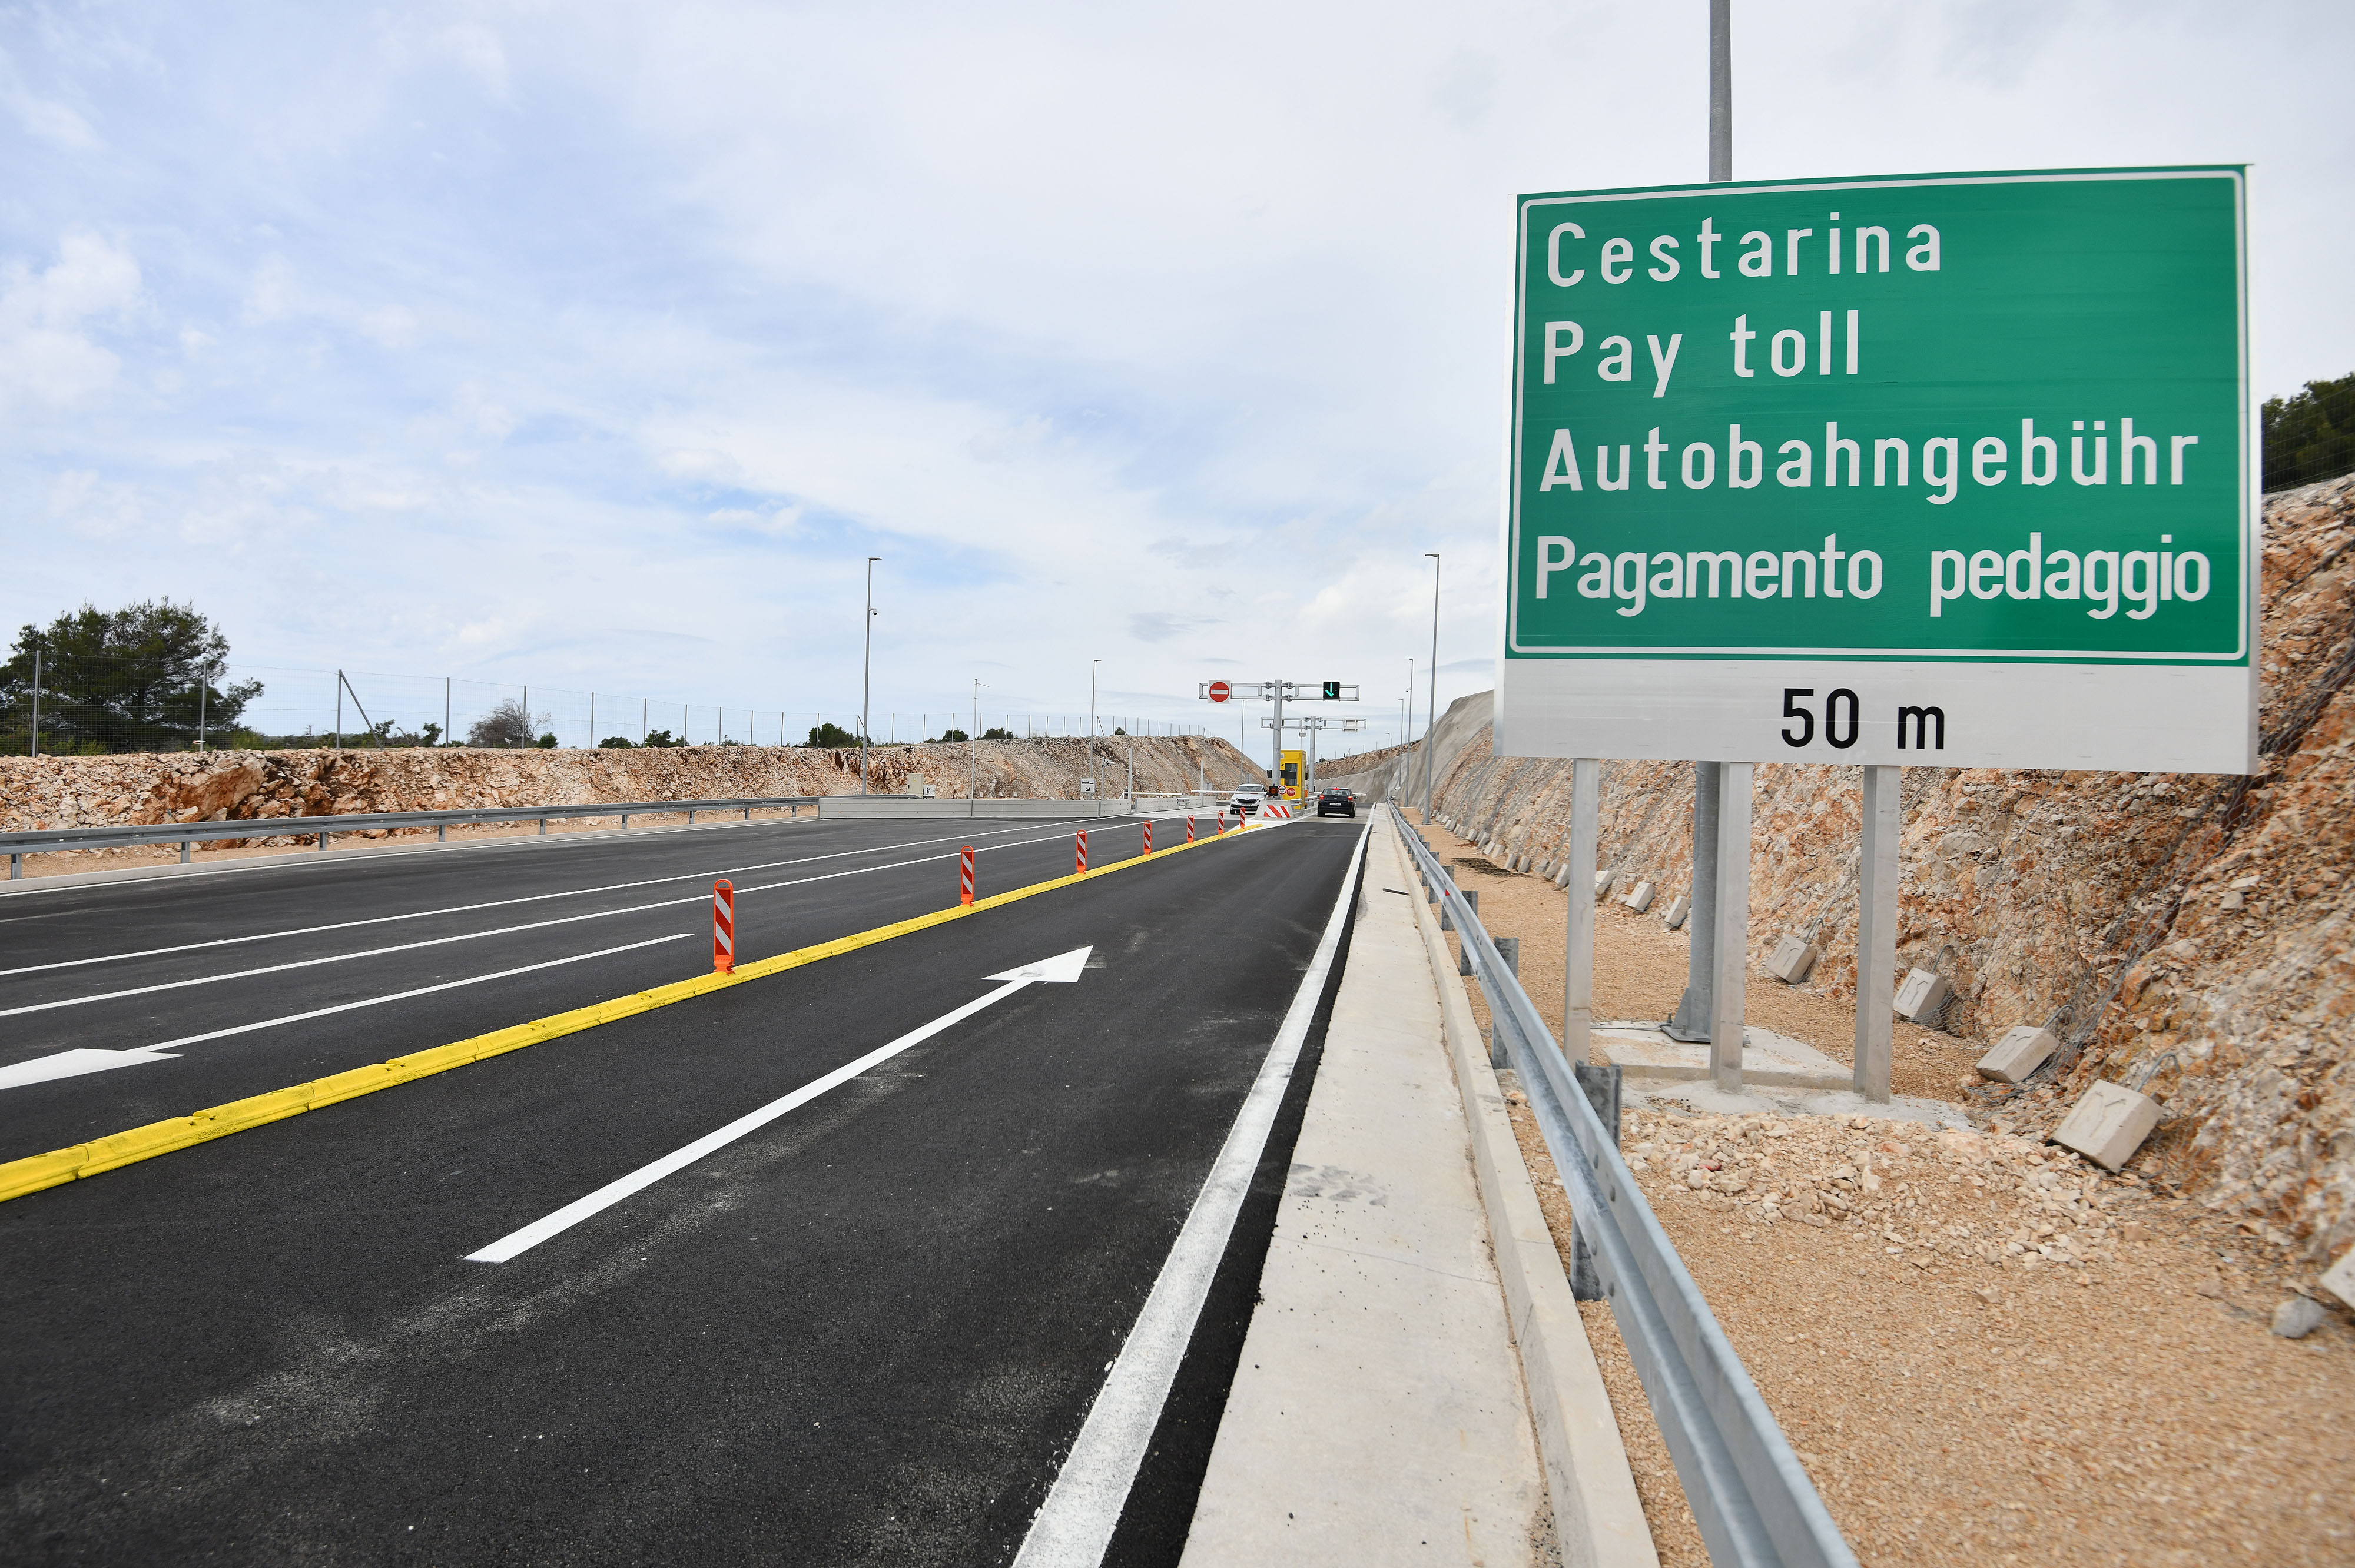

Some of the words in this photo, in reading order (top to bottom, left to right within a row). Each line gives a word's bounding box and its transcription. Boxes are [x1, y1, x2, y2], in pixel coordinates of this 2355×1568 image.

[1547, 212, 1941, 288] Cestarina
[1543, 320, 1683, 399] Pay
[1729, 310, 1859, 378] toll
[1538, 417, 2199, 506] Autobahngebühr
[1535, 532, 1883, 618] Pagamento
[1929, 531, 2211, 620] pedaggio
[1782, 688, 1859, 749] 50
[1897, 706, 1945, 750] m
